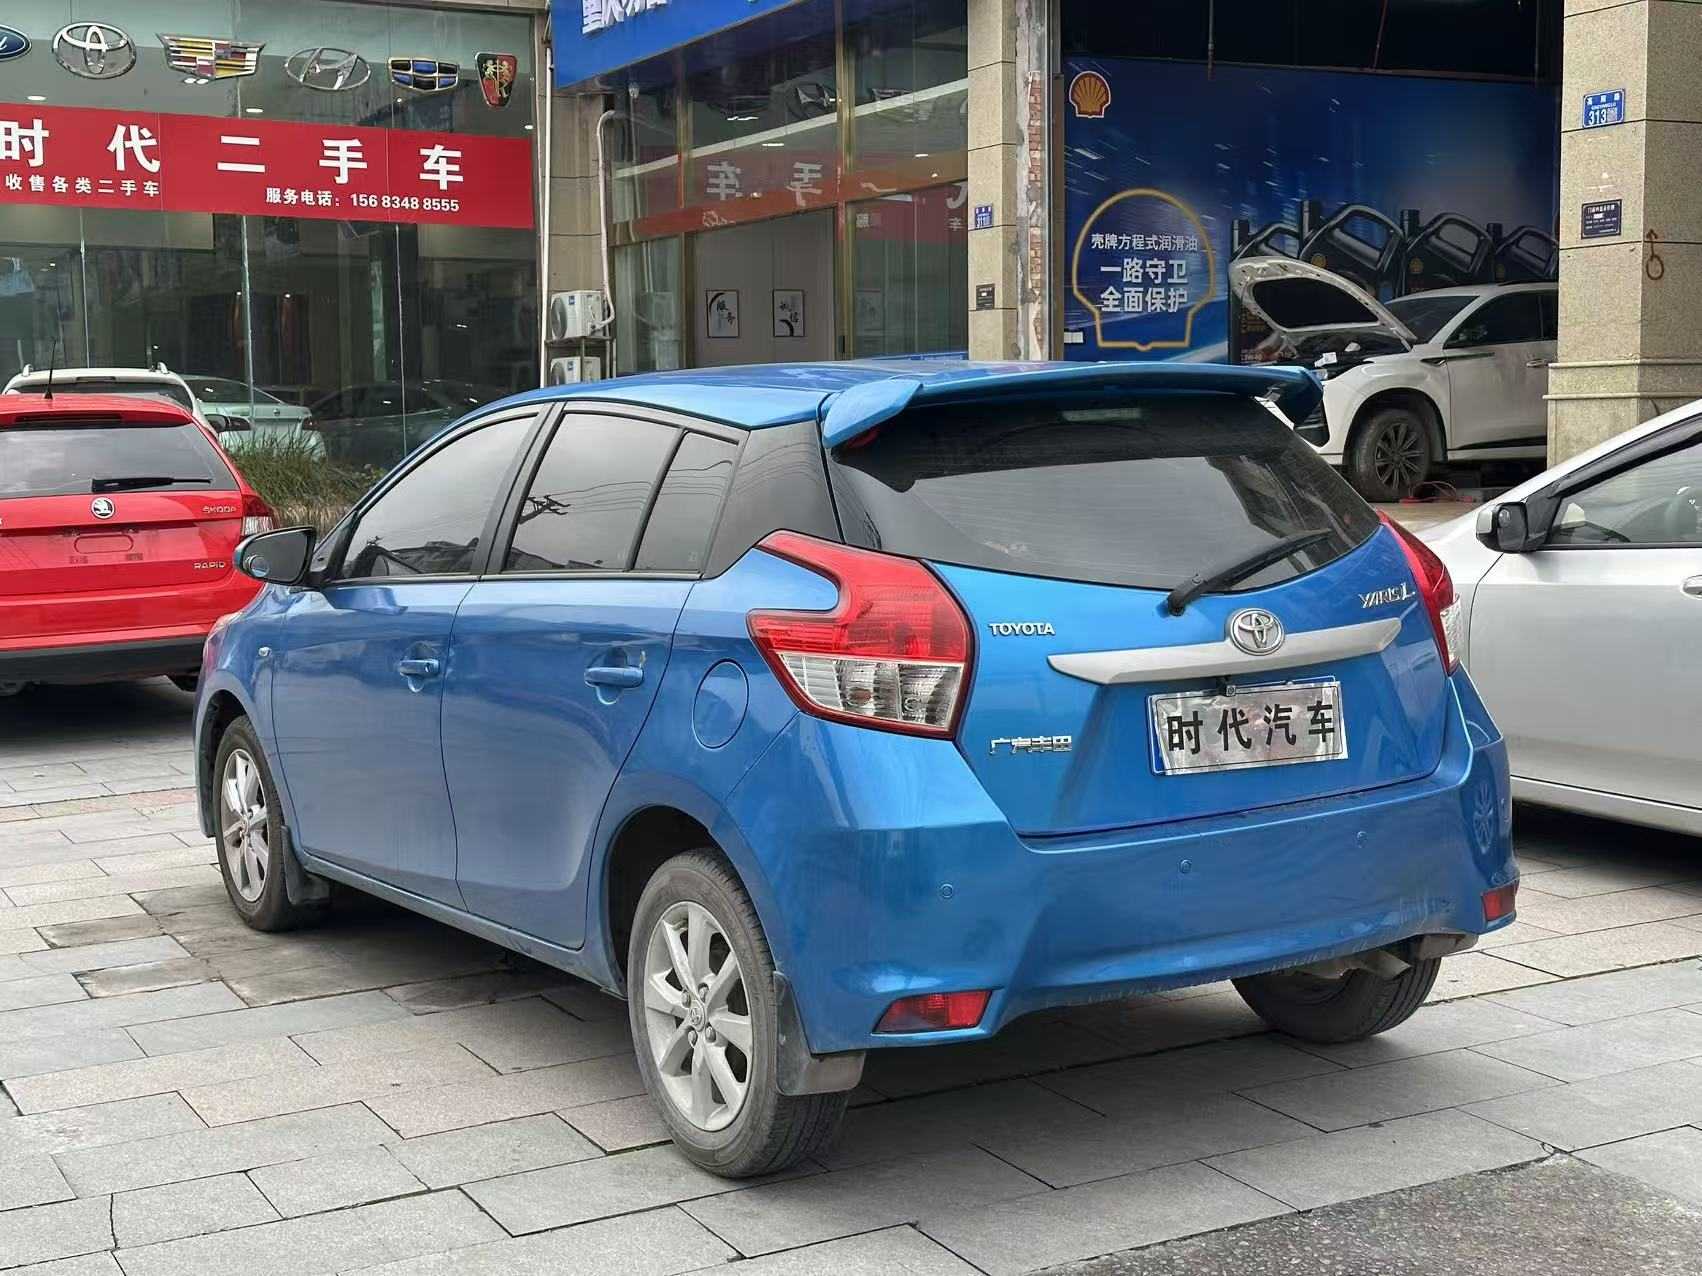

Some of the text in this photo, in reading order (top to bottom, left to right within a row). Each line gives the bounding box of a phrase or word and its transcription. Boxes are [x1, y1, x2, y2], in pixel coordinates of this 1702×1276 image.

[0, 118, 464, 191] 时代二手车
[5, 172, 160, 197] 收售各类二手车
[350, 193, 377, 207] 156
[382, 195, 419, 209] 8348
[423, 198, 460, 212] 8555
[1091, 233, 1198, 251] 壳牌方程式润滑油
[1100, 257, 1188, 284] 一路守卫
[1100, 286, 1188, 313] 全面保护
[989, 622, 1056, 635] TOYOTA
[1166, 700, 1336, 755] 时代汽车
